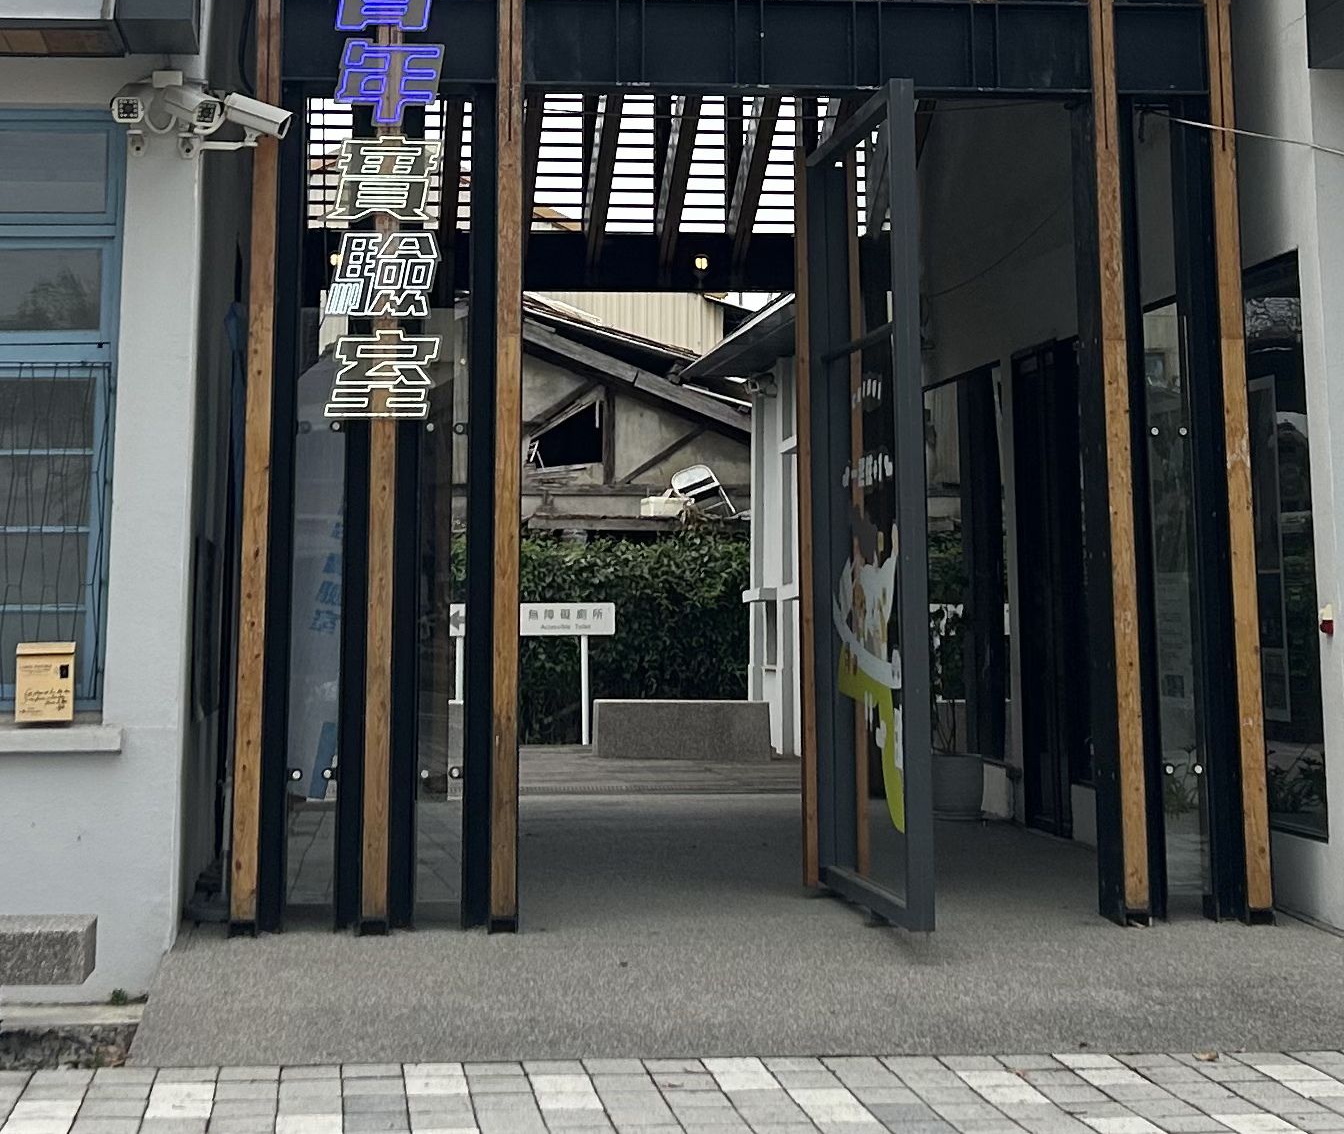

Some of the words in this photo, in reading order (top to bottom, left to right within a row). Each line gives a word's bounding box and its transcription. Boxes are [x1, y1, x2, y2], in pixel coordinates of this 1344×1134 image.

[528, 608, 603, 621] 無障礙廁所
